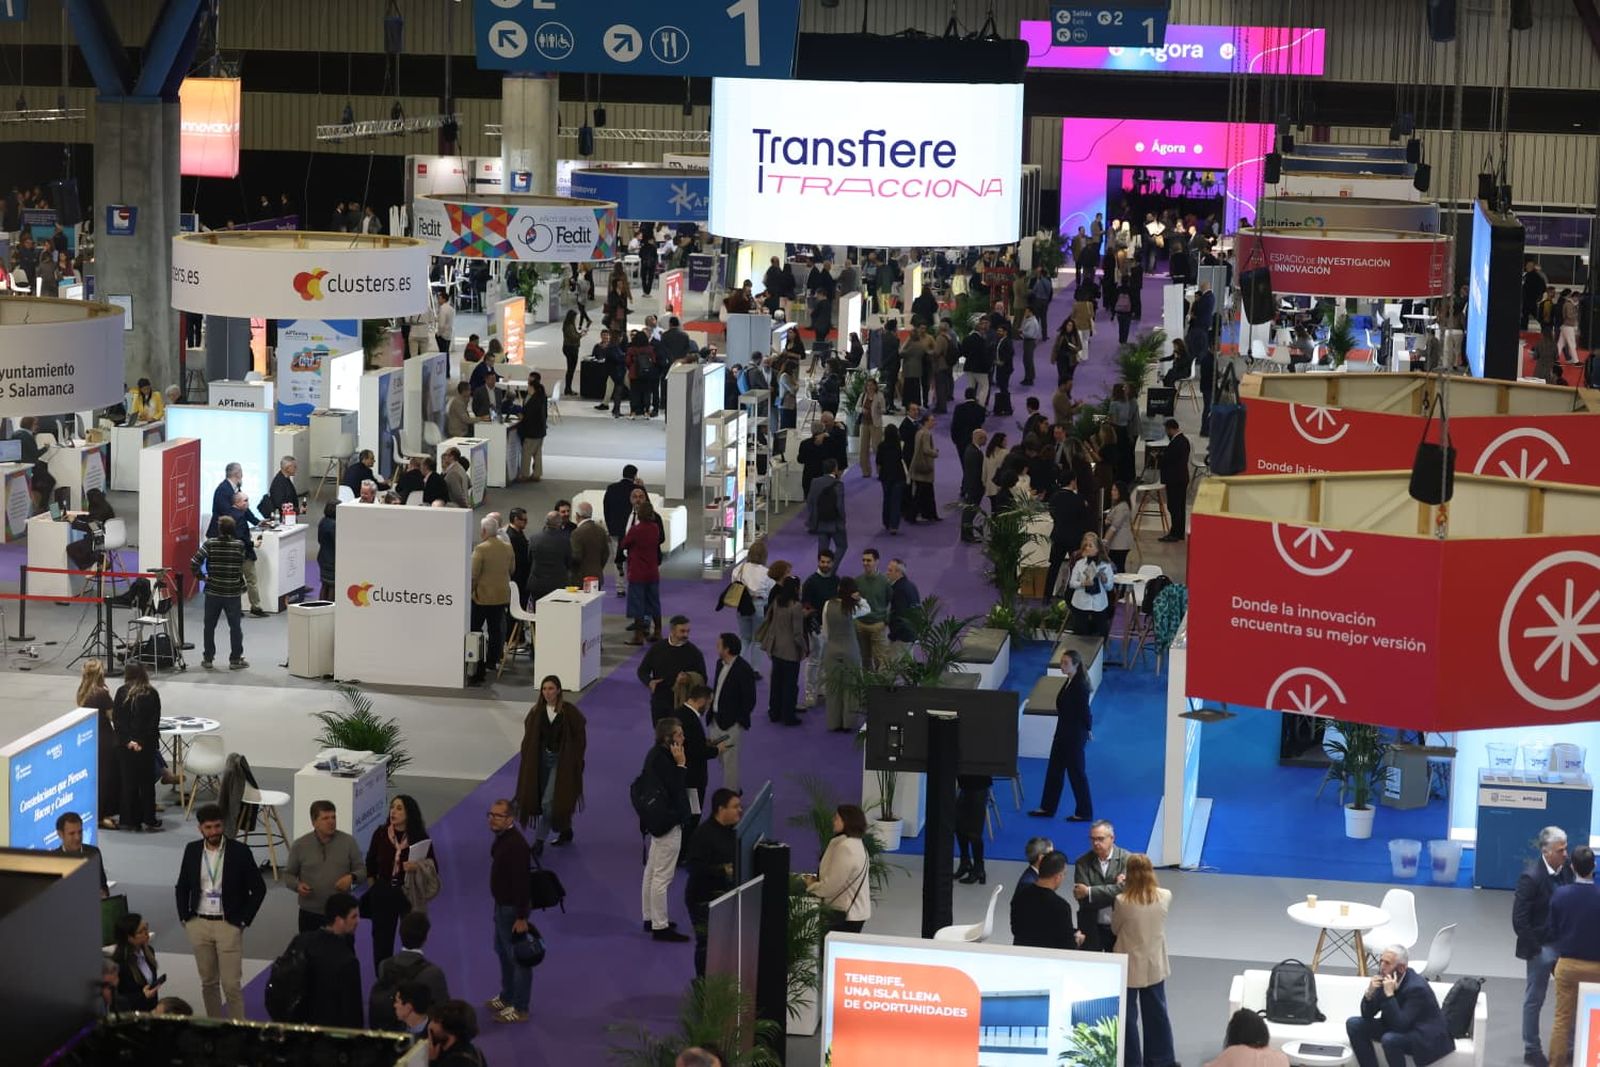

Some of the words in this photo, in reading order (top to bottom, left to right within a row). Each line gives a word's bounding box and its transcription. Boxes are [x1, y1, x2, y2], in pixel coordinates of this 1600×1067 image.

[1114, 11, 1124, 25] 2
[726, 0, 760, 66] 1
[1142, 18, 1154, 44] 1
[752, 128, 957, 168] Transfiere
[1151, 138, 1186, 155] Ágora
[418, 217, 442, 237] Fedit
[556, 226, 592, 245] Fedit
[1269, 252, 1305, 264] ESPACIO
[1306, 256, 1317, 265] DE
[1317, 254, 1391, 268] INVESTIGACIÓN
[1275, 264, 1331, 276] INNOVACIÓN
[328, 274, 411, 293] clusters.es
[0, 363, 75, 380] yuntamiento
[9, 383, 75, 398] Salamanca
[1258, 459, 1293, 473] Donde
[372, 587, 453, 606] clusters.es
[1231, 596, 1278, 614] Donde
[1282, 602, 1294, 616] la
[1298, 604, 1376, 627] innovación
[1231, 616, 1302, 636] encuentra
[1306, 627, 1323, 638] su
[1327, 630, 1369, 646] mejor
[1372, 637, 1426, 652] versión
[844, 986, 870, 997] UNA
[873, 988, 900, 1000] ISLA
[902, 990, 941, 1002] LLENA
[844, 999, 861, 1009] DE
[863, 1000, 968, 1018] OPORTUNIDADES
